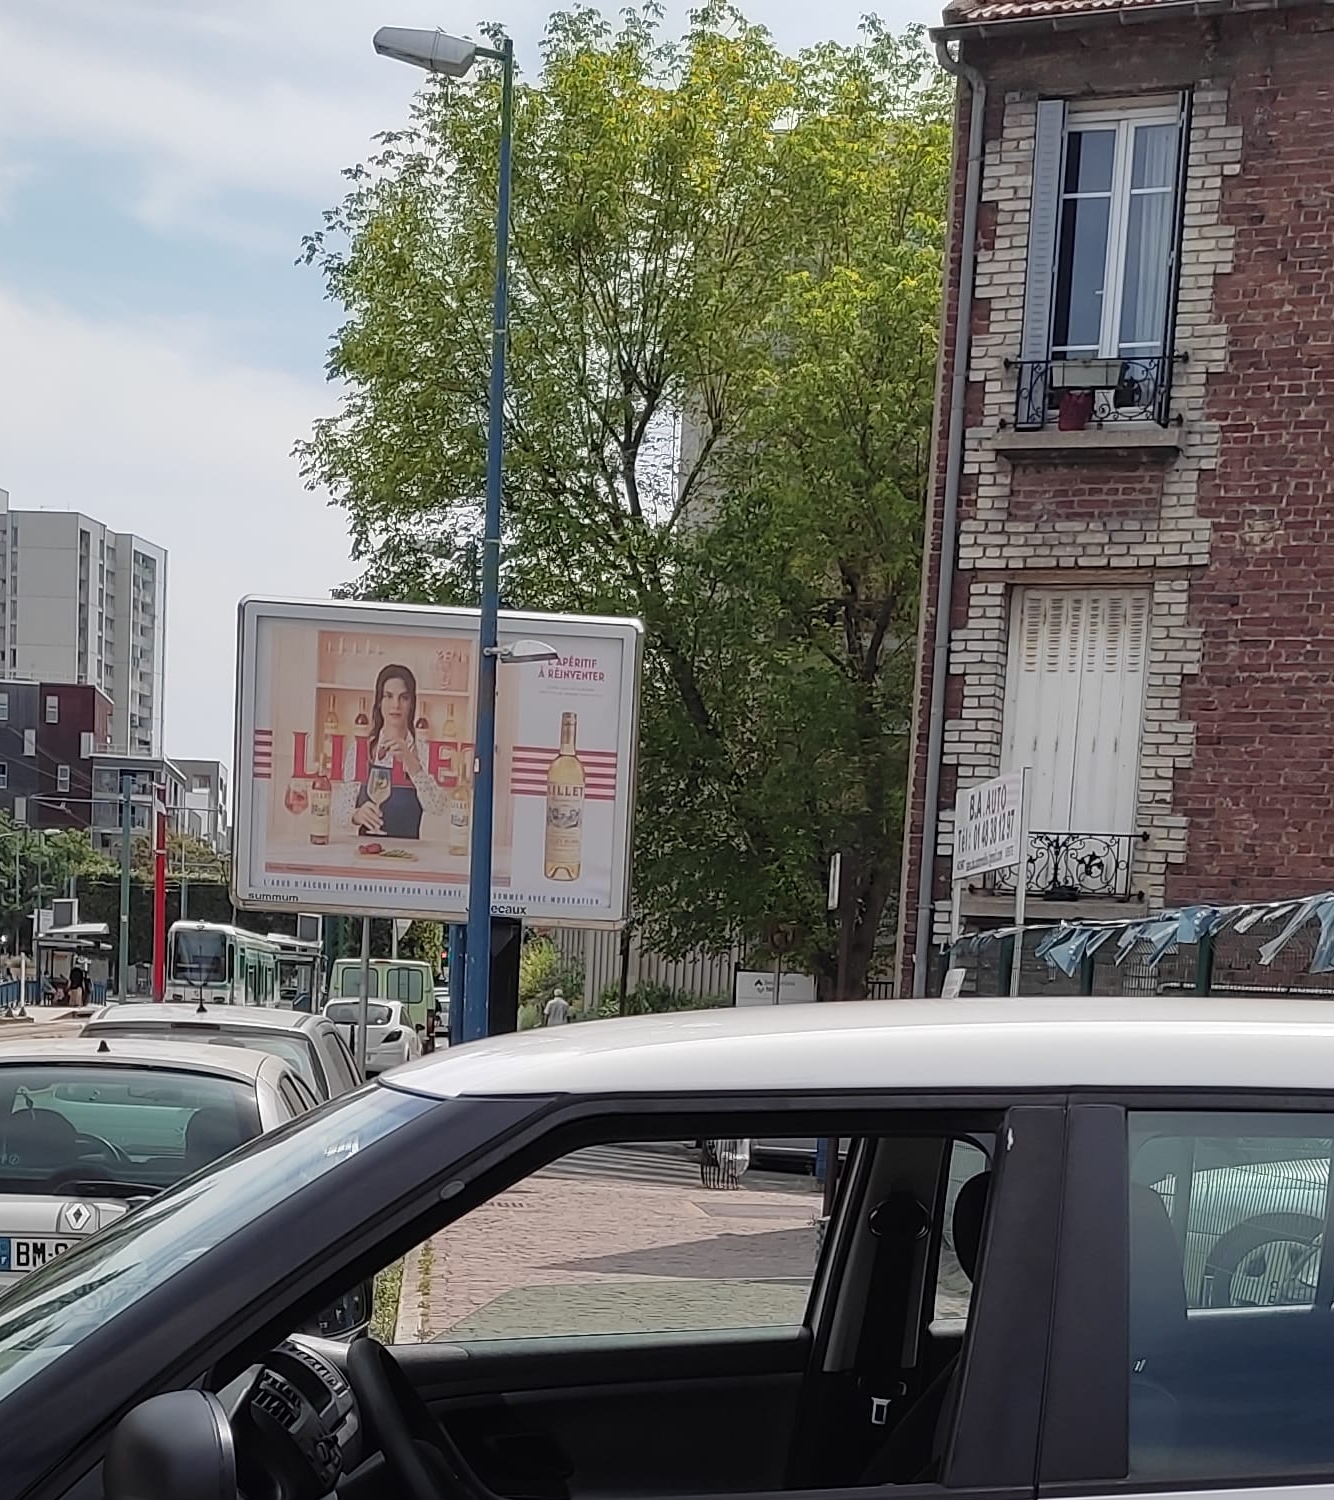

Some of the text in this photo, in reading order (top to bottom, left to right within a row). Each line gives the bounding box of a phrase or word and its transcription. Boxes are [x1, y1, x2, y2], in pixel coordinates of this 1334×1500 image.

[548, 655, 597, 669] LAPÉRITIF
[548, 667, 605, 681] RÉINVENTER
[247, 892, 299, 902] summum
[466, 903, 527, 916] ecaux
